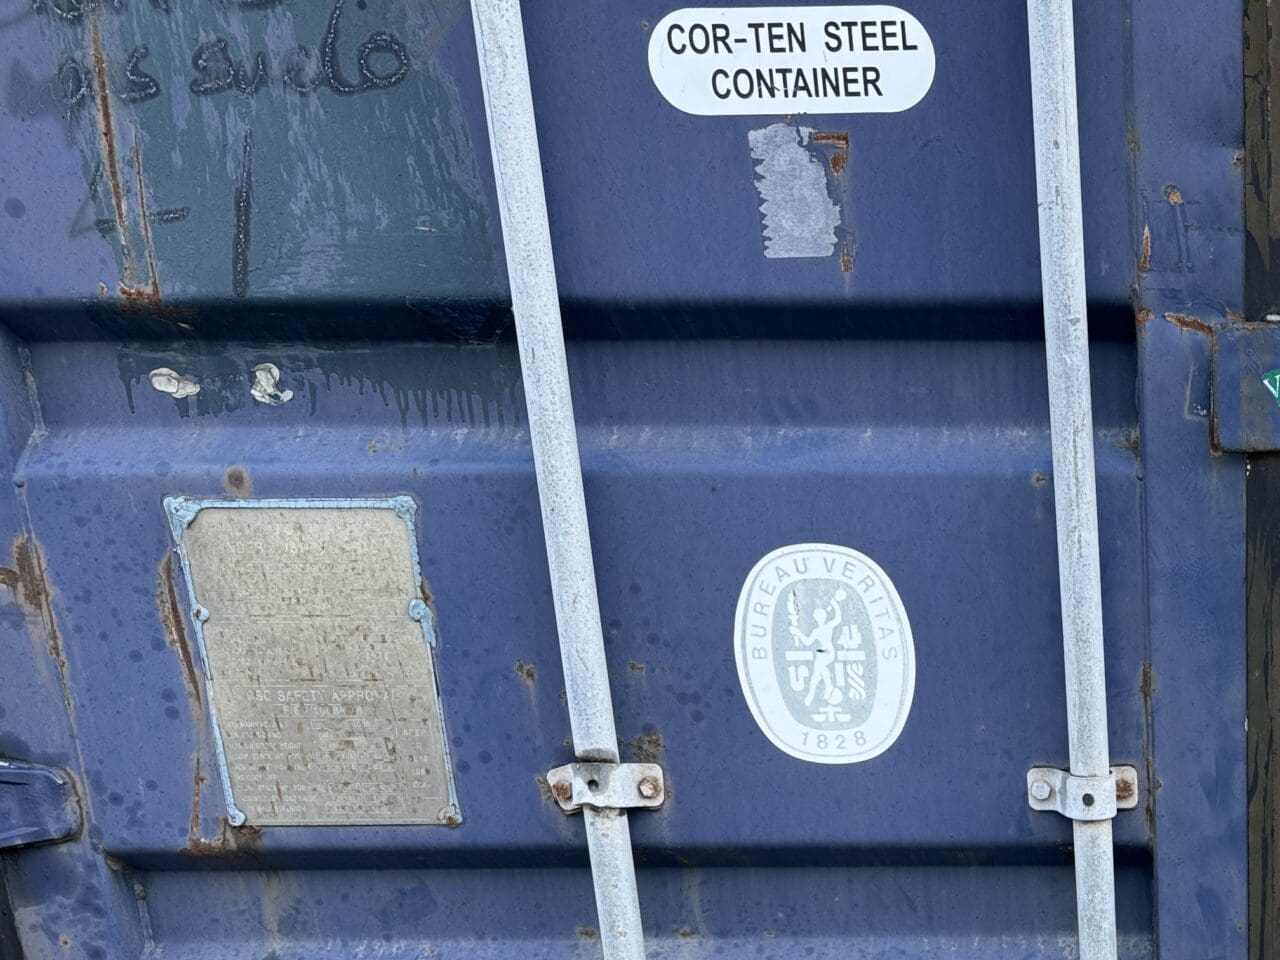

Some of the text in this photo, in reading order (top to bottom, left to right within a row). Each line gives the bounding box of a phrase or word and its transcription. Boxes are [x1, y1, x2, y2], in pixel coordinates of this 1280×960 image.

[667, 20, 918, 54] COR-TEN STEEL
[711, 66, 883, 100] CONTAINER
[752, 557, 898, 661] BUREAU VERITAS
[801, 731, 867, 750] 1828
